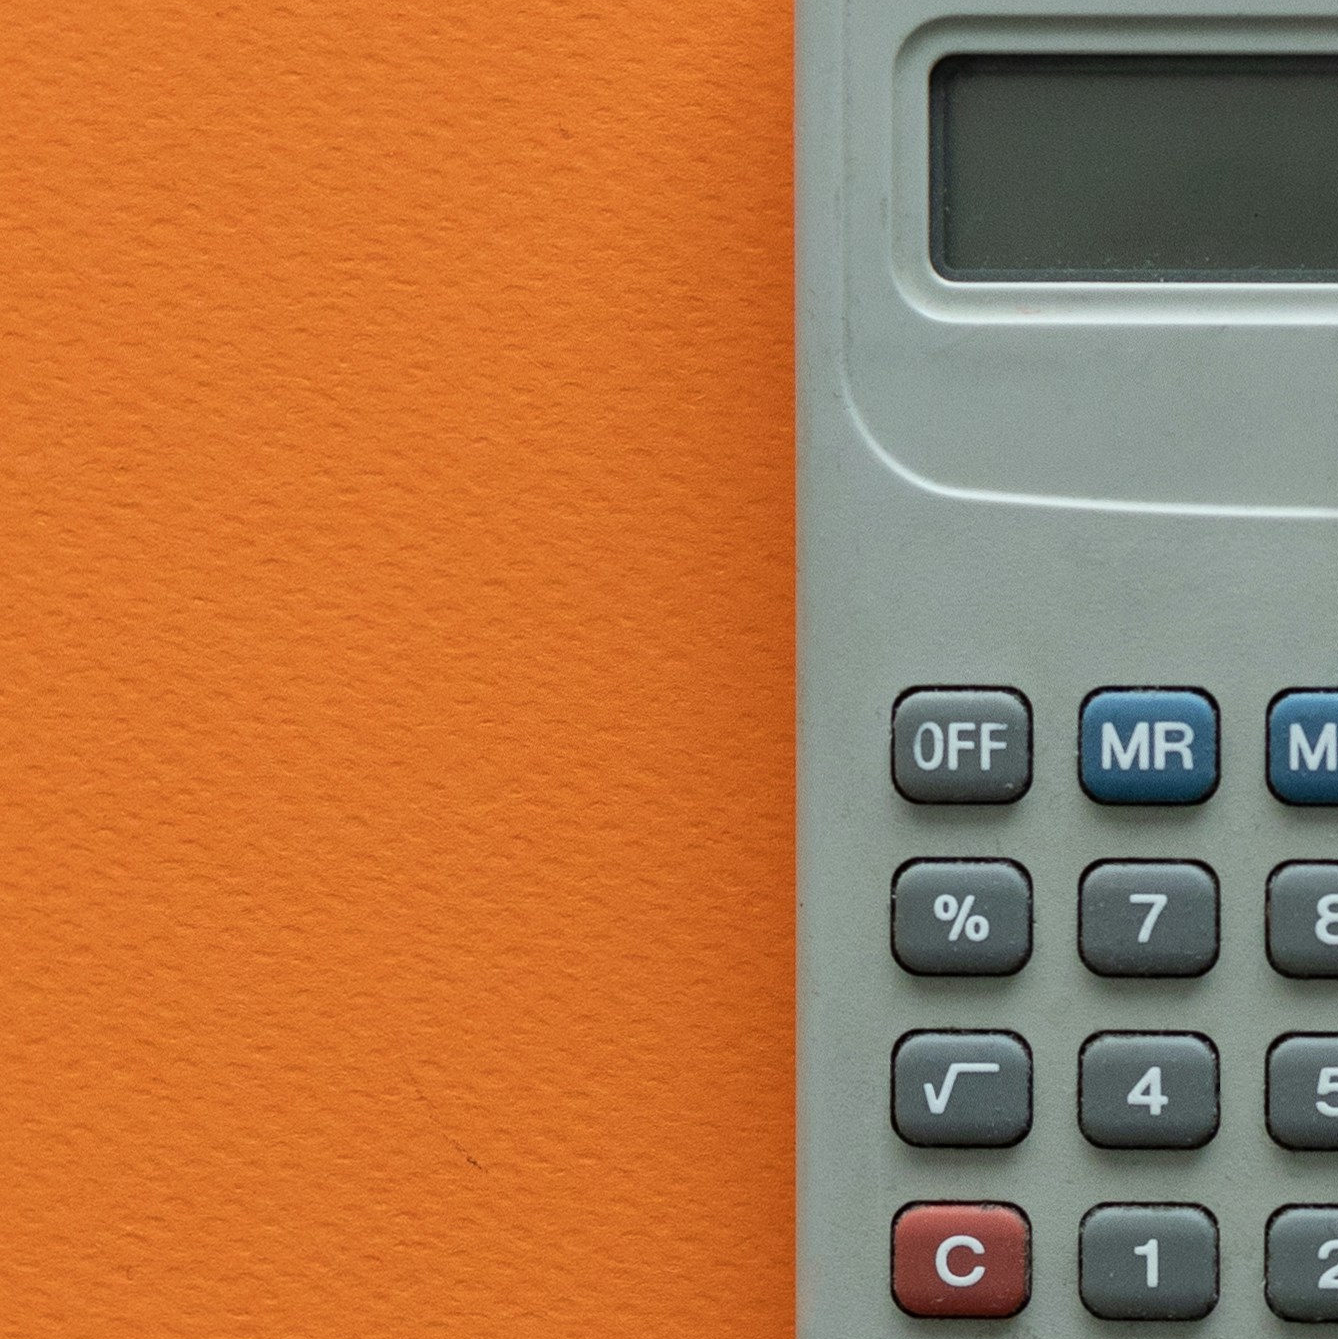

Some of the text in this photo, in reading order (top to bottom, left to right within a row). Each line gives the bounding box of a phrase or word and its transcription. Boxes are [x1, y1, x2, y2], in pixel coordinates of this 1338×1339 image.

[1101, 721, 1195, 771] MR
[932, 894, 991, 943] %
[1128, 893, 1169, 944] 7
[1126, 1065, 1170, 1117] 4
[934, 1235, 987, 1288] C
[1133, 1237, 1160, 1289] 1
